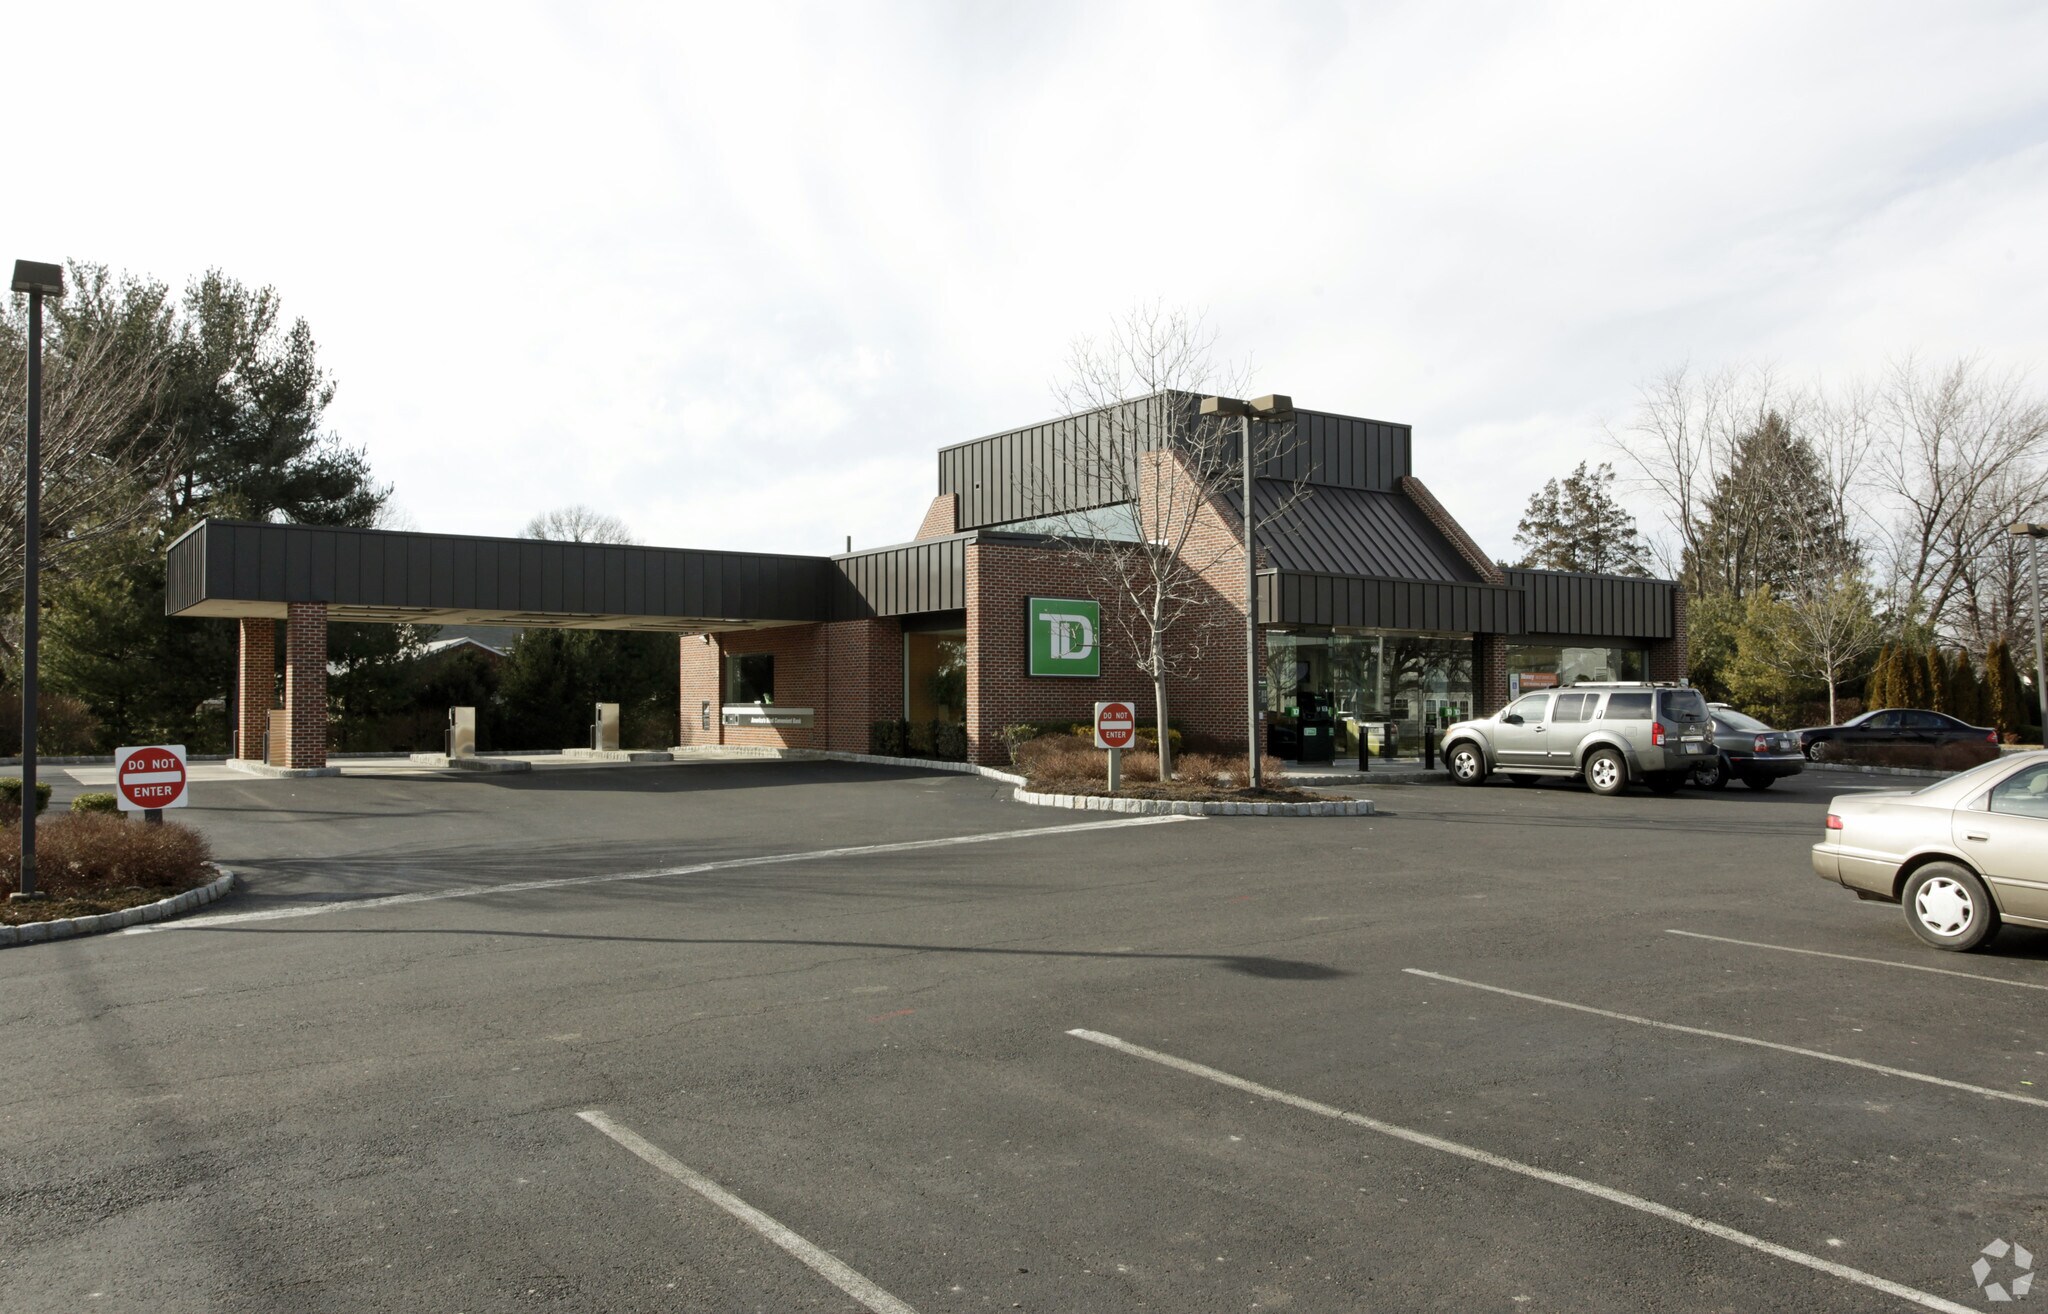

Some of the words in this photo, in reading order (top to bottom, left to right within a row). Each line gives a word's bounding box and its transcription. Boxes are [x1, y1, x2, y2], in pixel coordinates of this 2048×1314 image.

[1039, 613, 1093, 659] TD
[1106, 731, 1126, 739] ENTER
[128, 760, 145, 770] DO
[152, 758, 175, 769] NOT
[134, 786, 172, 797] ENTER
